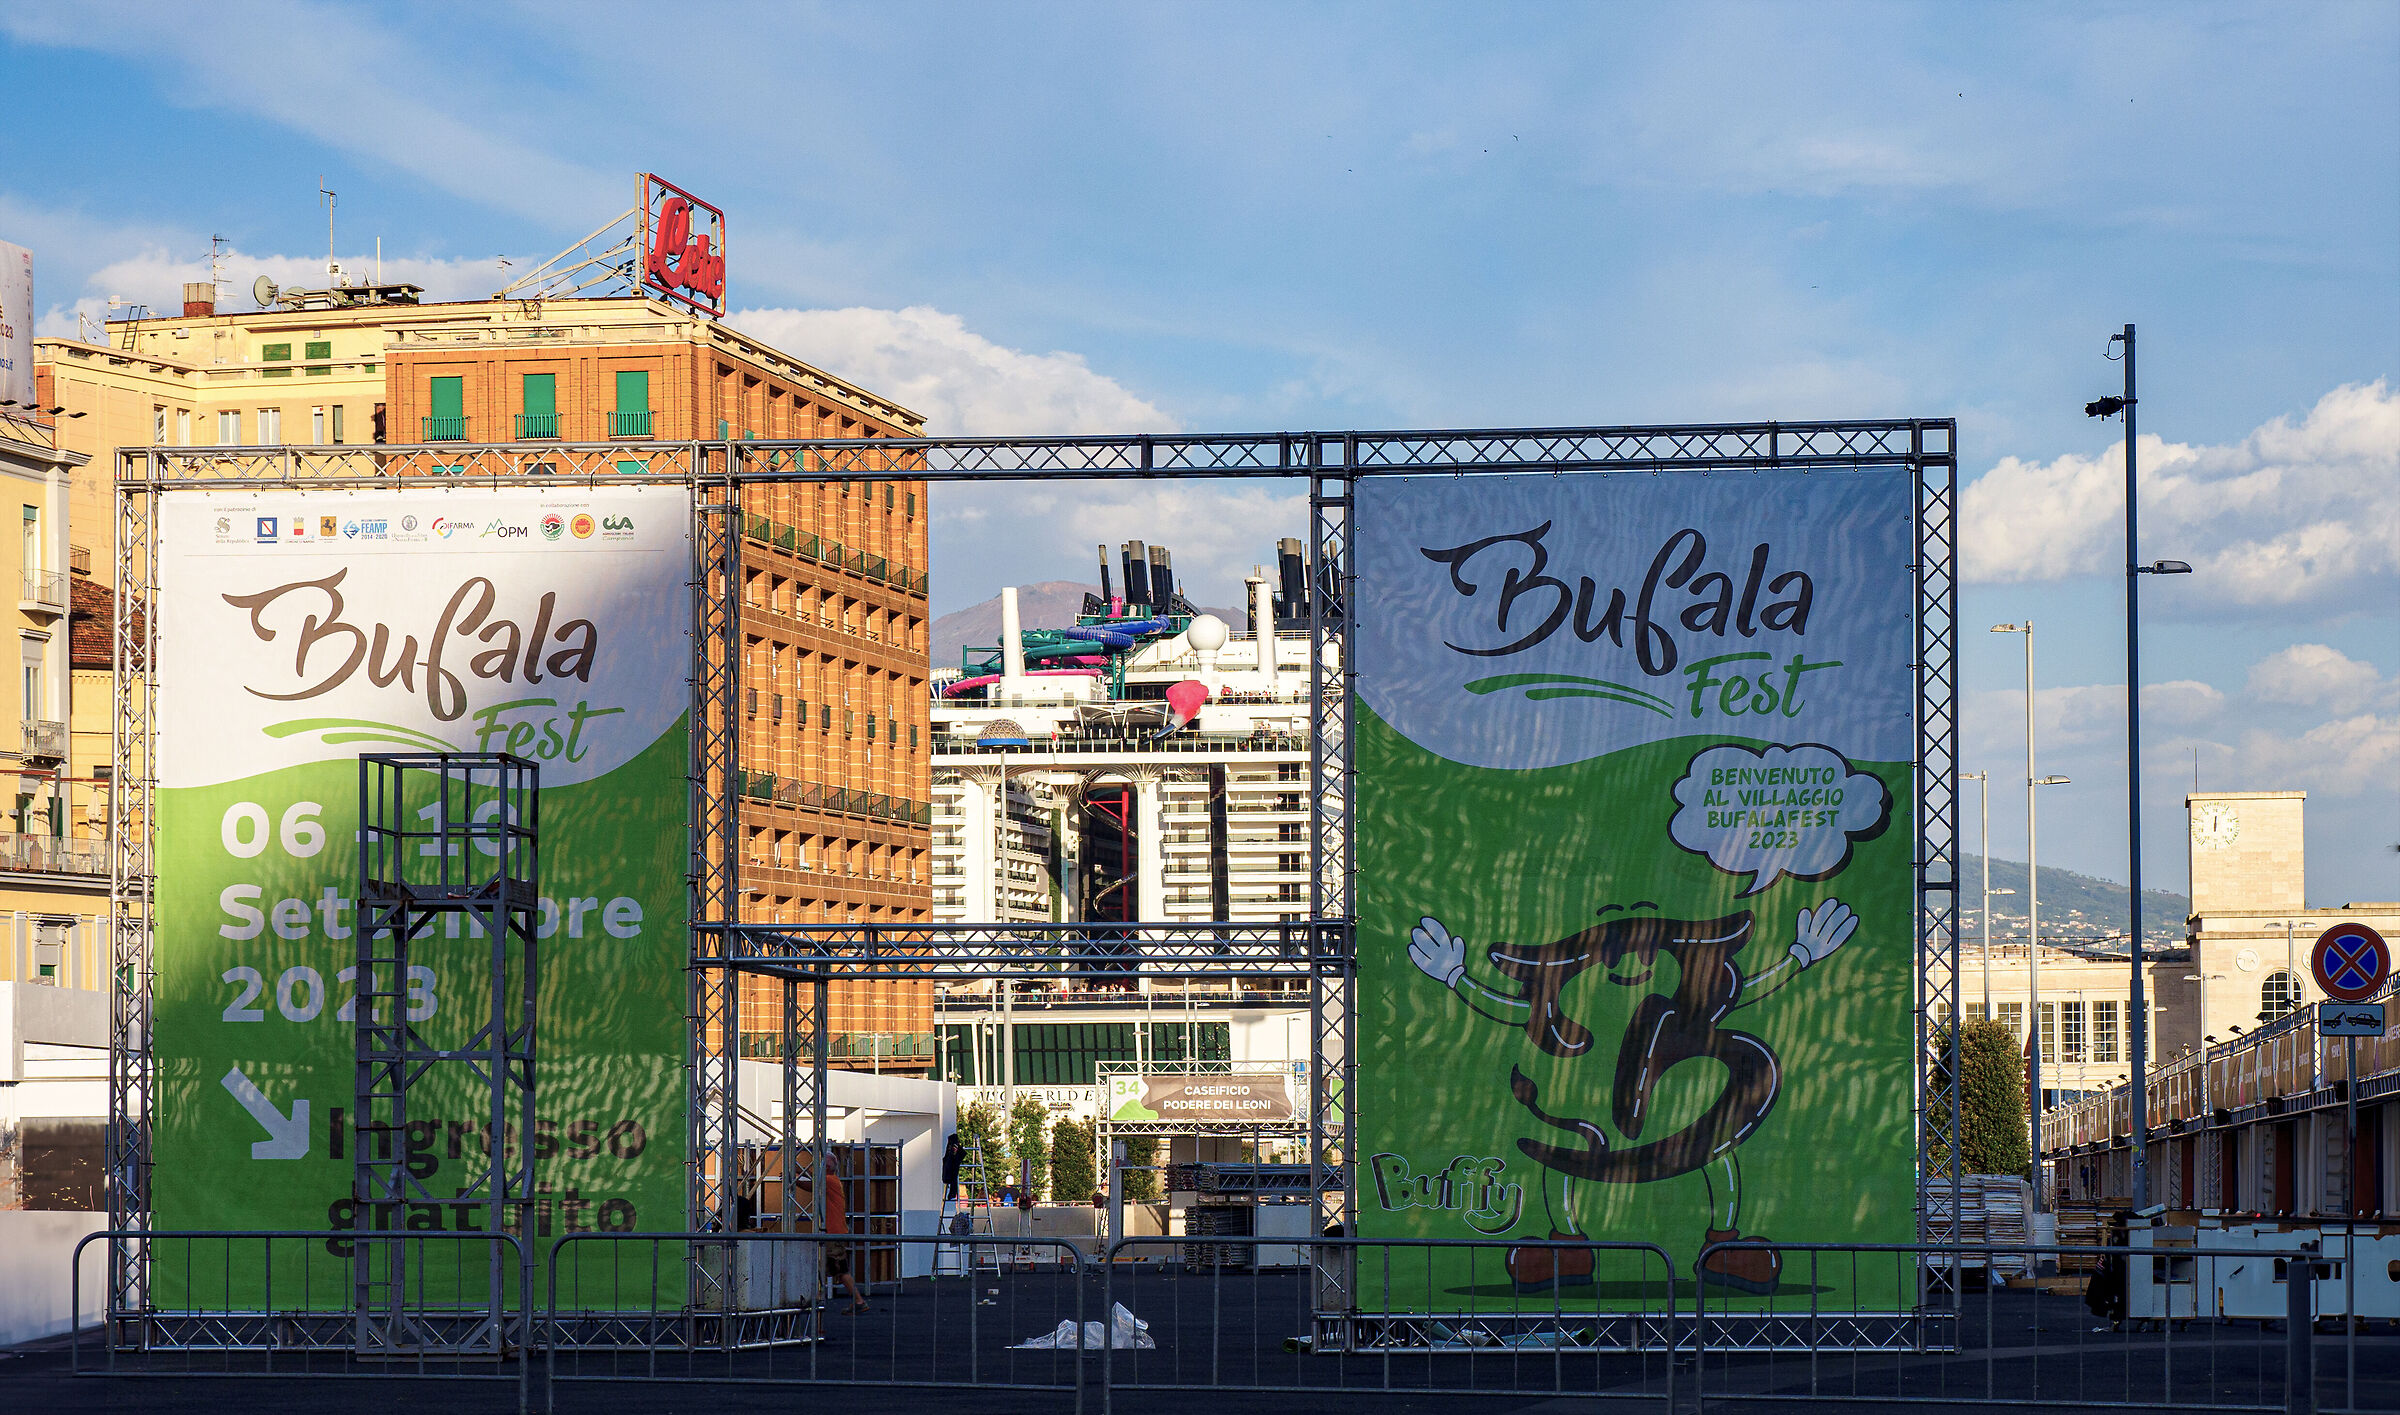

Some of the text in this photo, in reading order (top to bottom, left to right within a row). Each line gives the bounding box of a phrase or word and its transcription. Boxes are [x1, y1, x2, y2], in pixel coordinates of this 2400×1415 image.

[361, 522, 388, 533] FEAMP
[497, 526, 528, 538] OPM
[1420, 519, 1813, 676] Bufala
[221, 567, 598, 721] Bufala
[1684, 651, 1843, 719] Fest
[473, 698, 625, 763] Fest
[1711, 767, 1835, 786] BENVENUTO
[1703, 788, 1844, 807] AL VILLAGGIO
[1707, 810, 1840, 828] BUFALAFEST
[221, 801, 326, 858] 06
[1749, 831, 1799, 850] 2023
[221, 966, 438, 1022] 2023
[1115, 1080, 1140, 1095] 34
[1184, 1085, 1250, 1096] CASEIFICIO
[1163, 1099, 1271, 1110] PODERE DEI LEONI
[330, 1107, 647, 1179] Ingresso
[1370, 1152, 1524, 1235] Buffy
